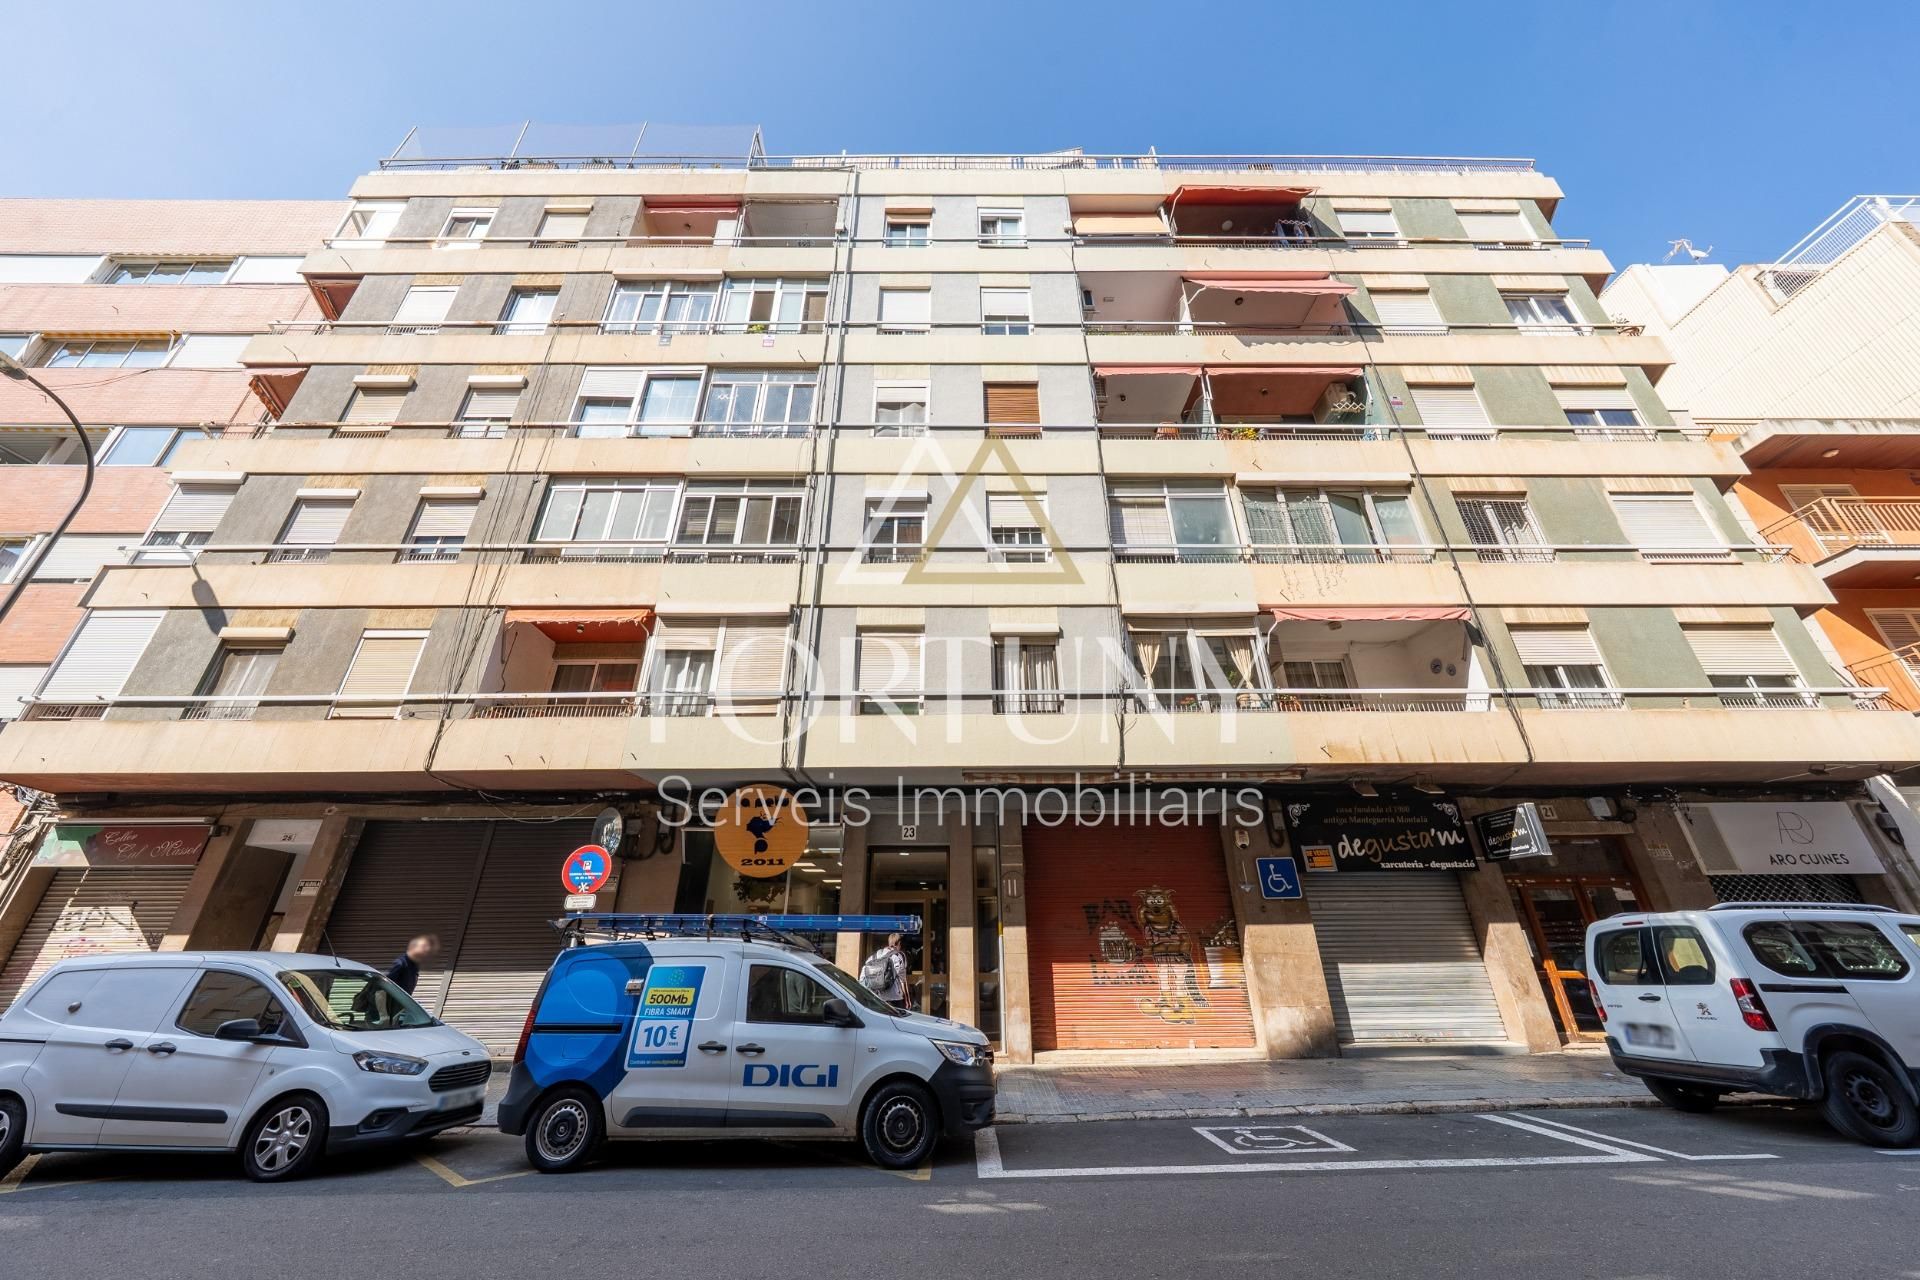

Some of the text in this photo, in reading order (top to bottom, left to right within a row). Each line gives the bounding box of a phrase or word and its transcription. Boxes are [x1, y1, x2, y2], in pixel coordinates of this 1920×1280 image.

[1542, 807, 1554, 818] 21
[903, 827, 915, 838] 23
[1337, 828, 1465, 863] degusta'm
[740, 858, 785, 866] 2011
[1380, 860, 1424, 869] xarcuteria
[1430, 859, 1475, 870] degustació
[1769, 853, 1850, 865] ARO CUINES
[649, 993, 688, 1005] 500Mb
[644, 1007, 691, 1016] FIBRA SMART
[643, 1025, 680, 1048] 10 €
[743, 1064, 839, 1088] DIGI
